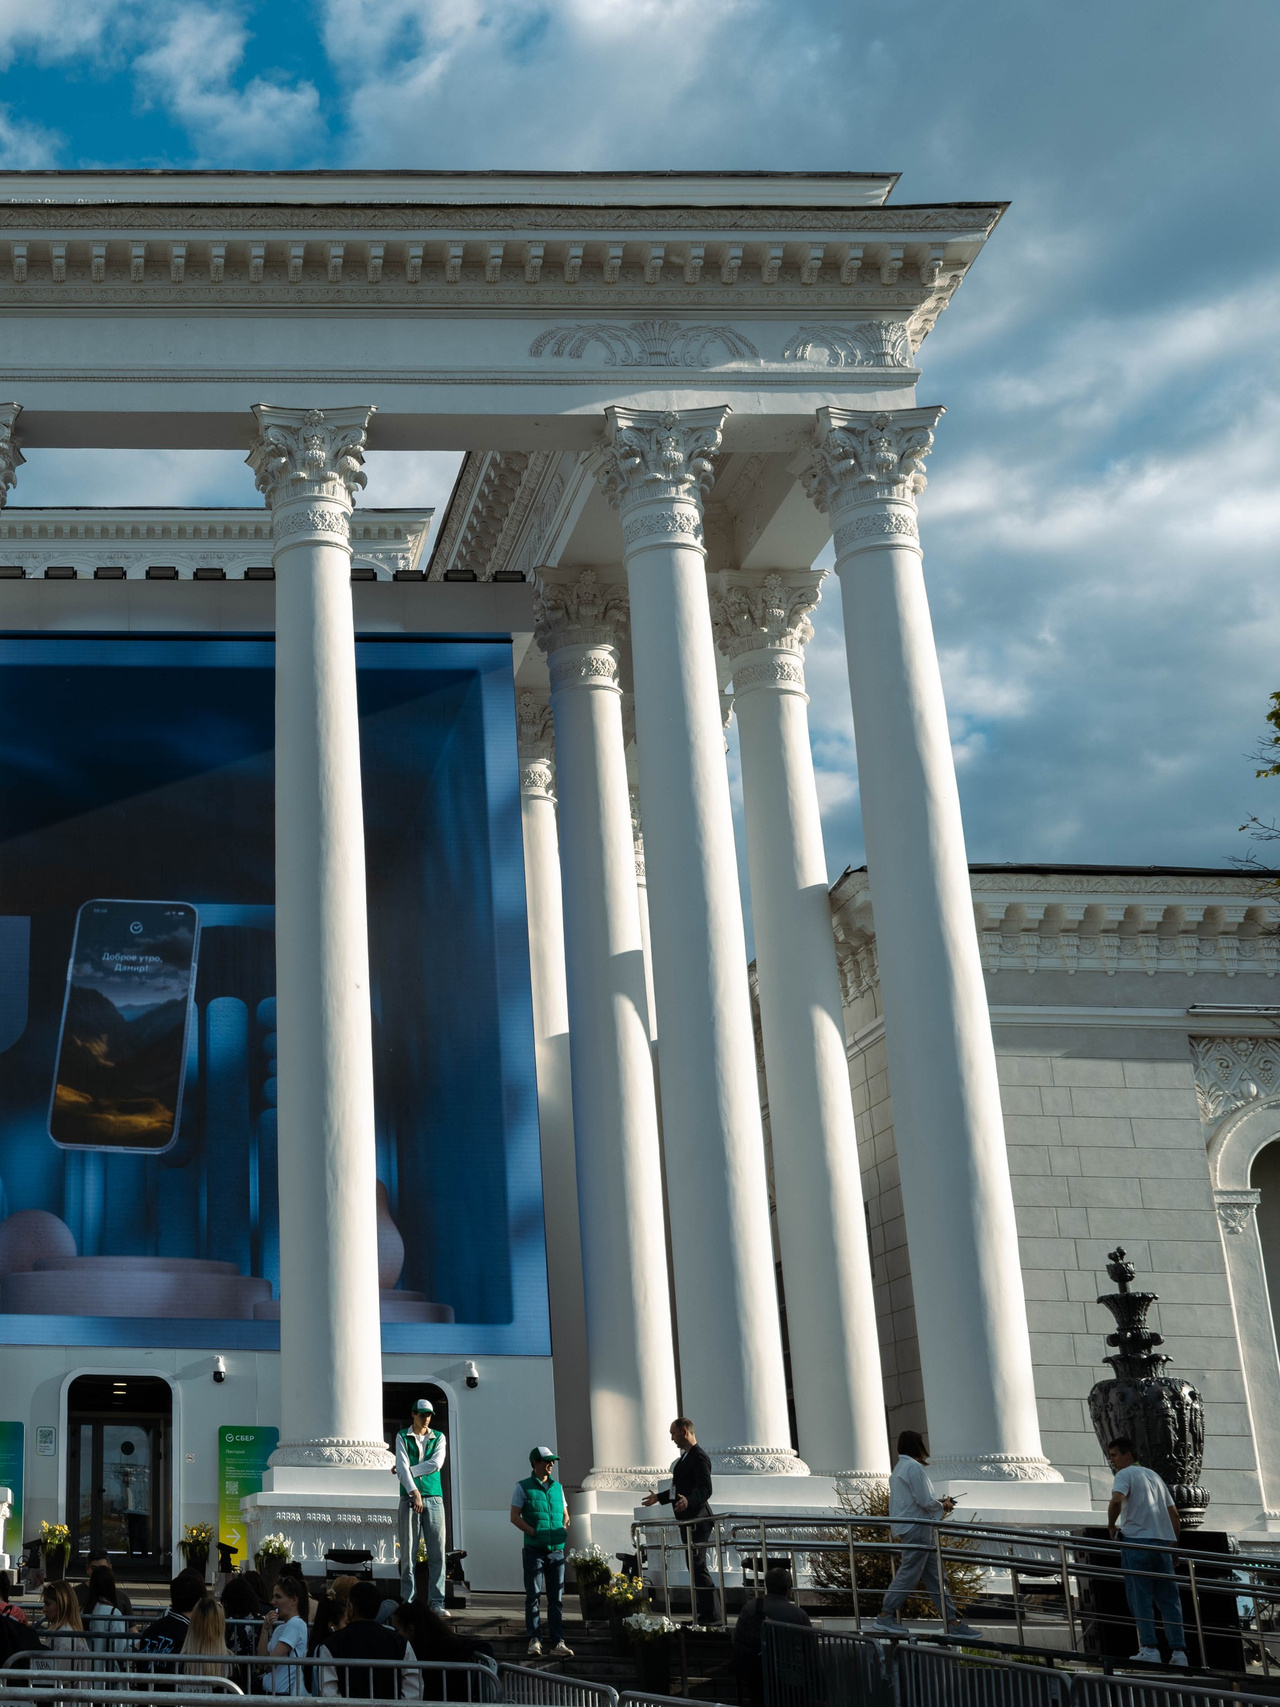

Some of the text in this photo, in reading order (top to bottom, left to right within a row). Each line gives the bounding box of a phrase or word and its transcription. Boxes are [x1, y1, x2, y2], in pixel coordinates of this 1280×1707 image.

[102, 952, 163, 963] Доброе утро,
[114, 963, 149, 973] Дамир!
